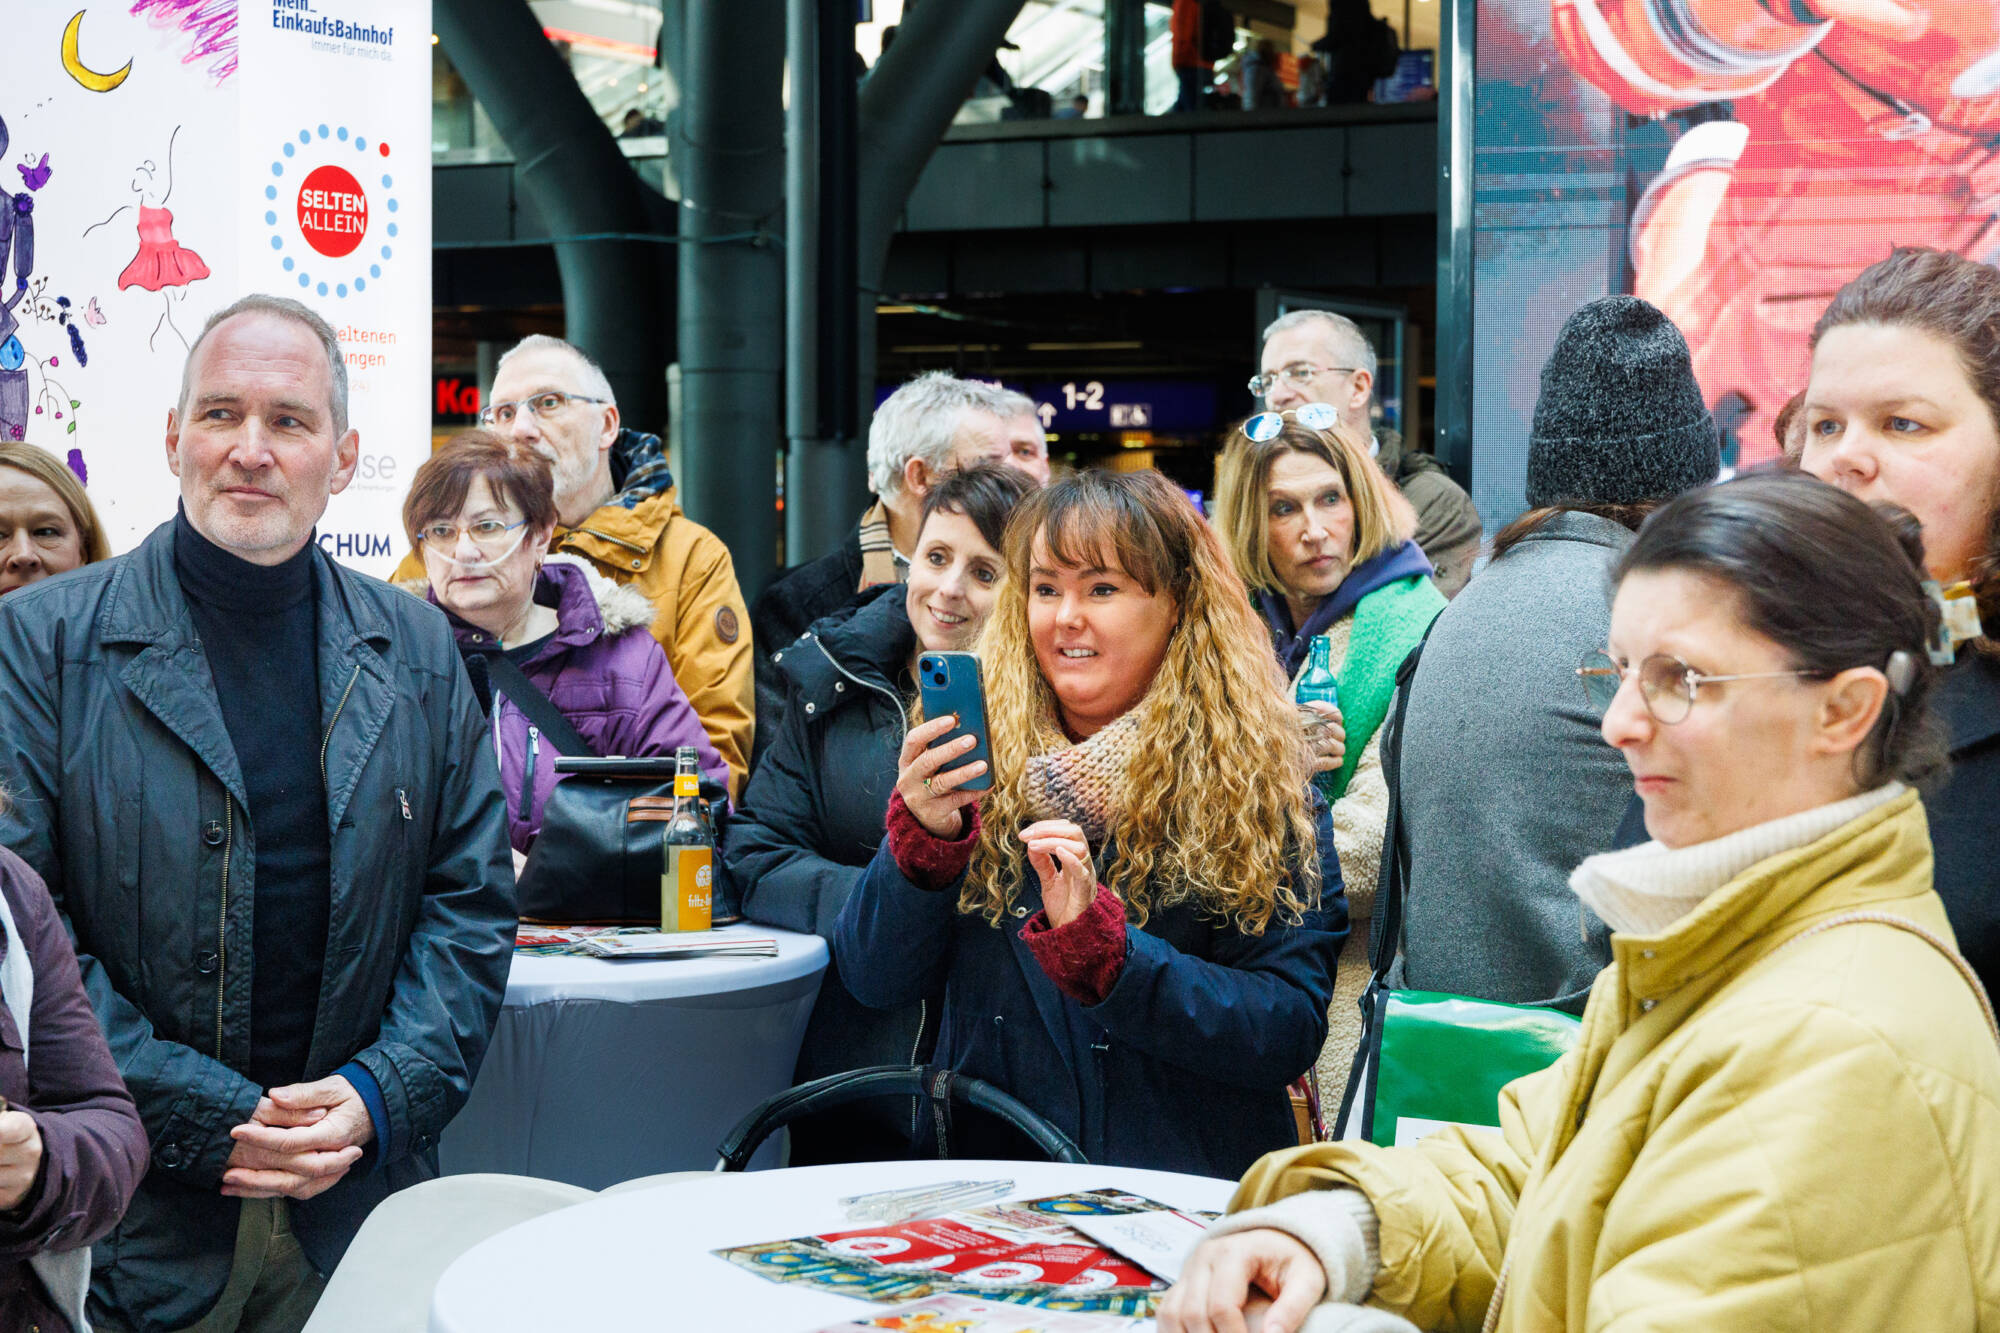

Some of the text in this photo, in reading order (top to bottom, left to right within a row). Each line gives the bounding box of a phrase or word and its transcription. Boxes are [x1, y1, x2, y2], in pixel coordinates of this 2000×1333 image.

[273, 9, 394, 46] EinkaufsBahnhof
[301, 189, 365, 213] SELTEN
[301, 210, 365, 235] ALLEIN
[333, 324, 397, 345] eltenen
[1062, 381, 1105, 411] 1-2
